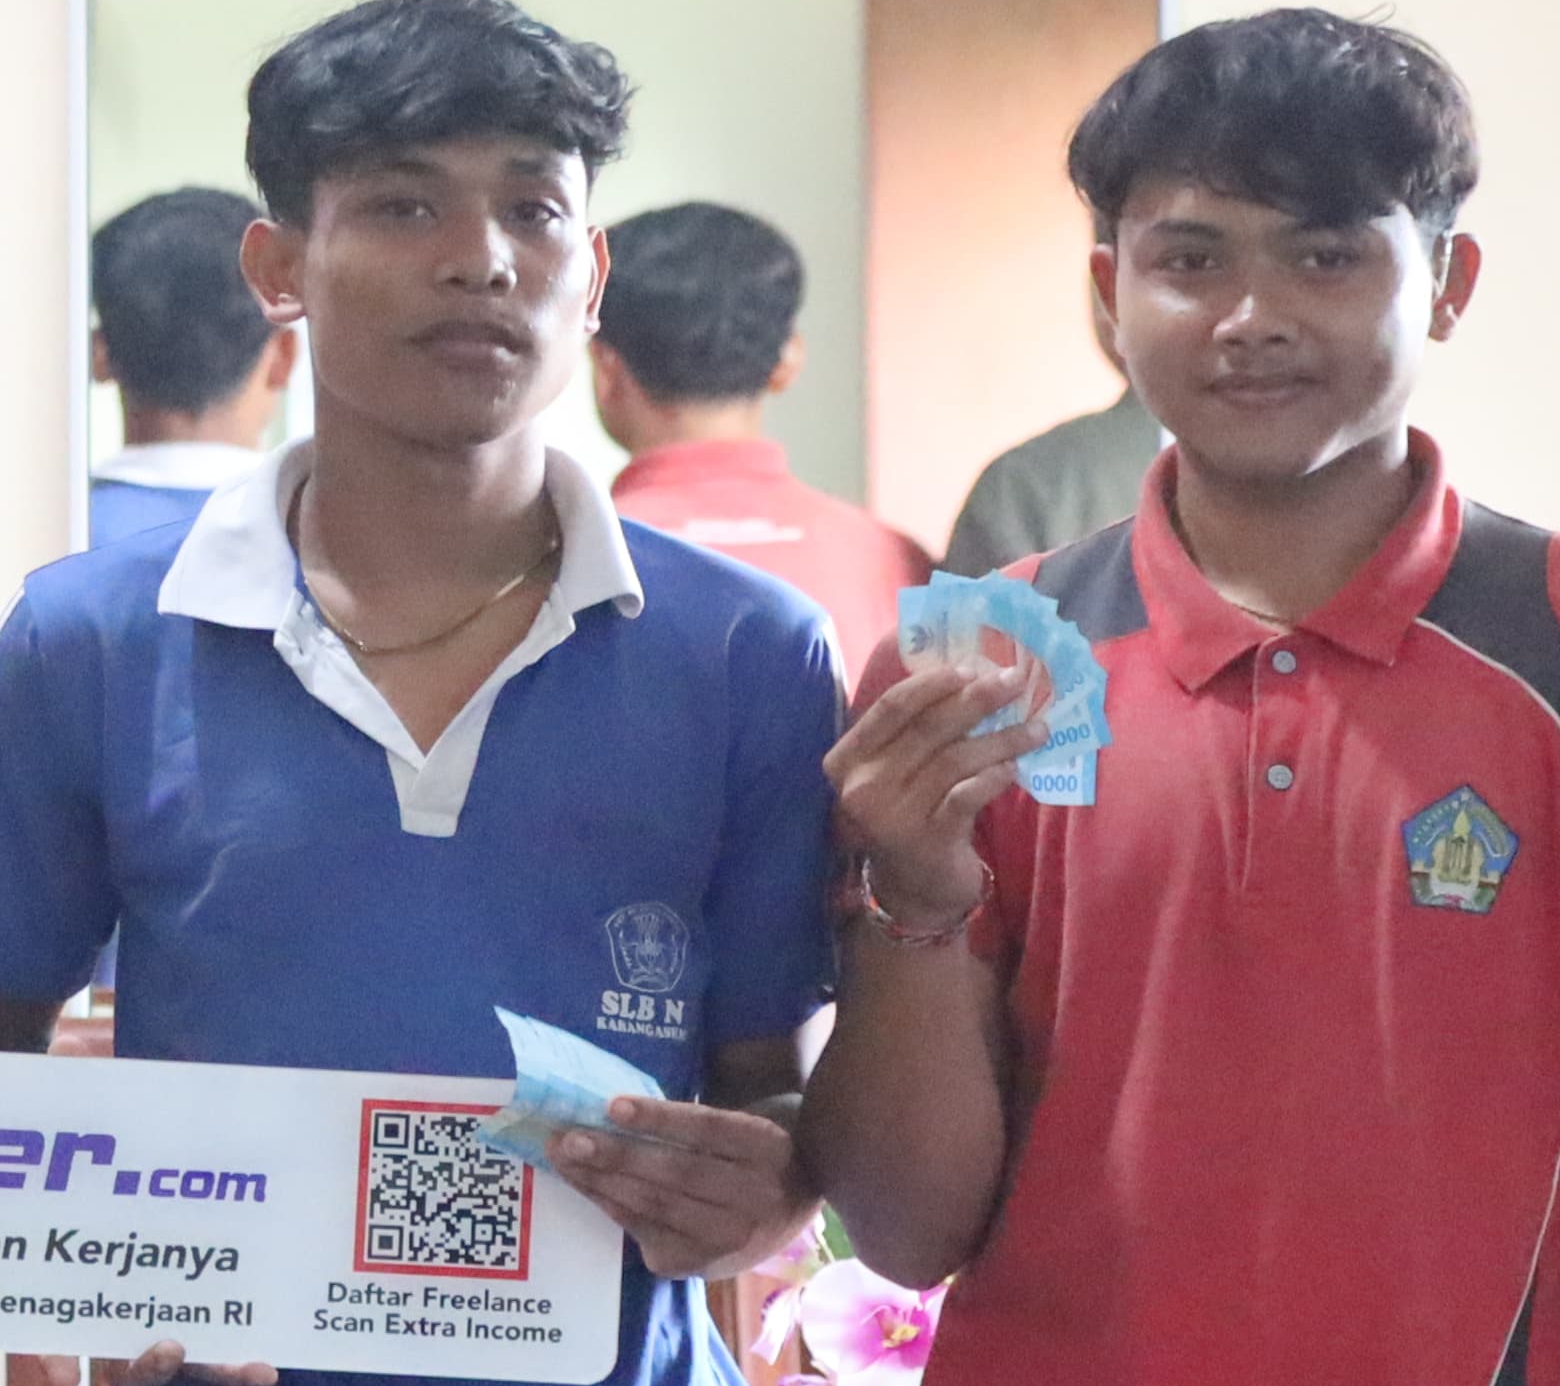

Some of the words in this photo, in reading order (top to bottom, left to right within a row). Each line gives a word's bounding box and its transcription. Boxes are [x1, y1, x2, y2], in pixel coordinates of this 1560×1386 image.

[1031, 773, 1079, 793] 0000
[601, 989, 656, 1022] SLB
[663, 998, 686, 1025] N
[44, 1228, 240, 1281] Kerjanya
[327, 1281, 412, 1307] Daftar
[422, 1286, 552, 1313] Freelance
[223, 1302, 253, 1327] RI
[313, 1310, 374, 1335] Scan
[384, 1313, 456, 1339] Extra
[466, 1317, 563, 1343] Income
